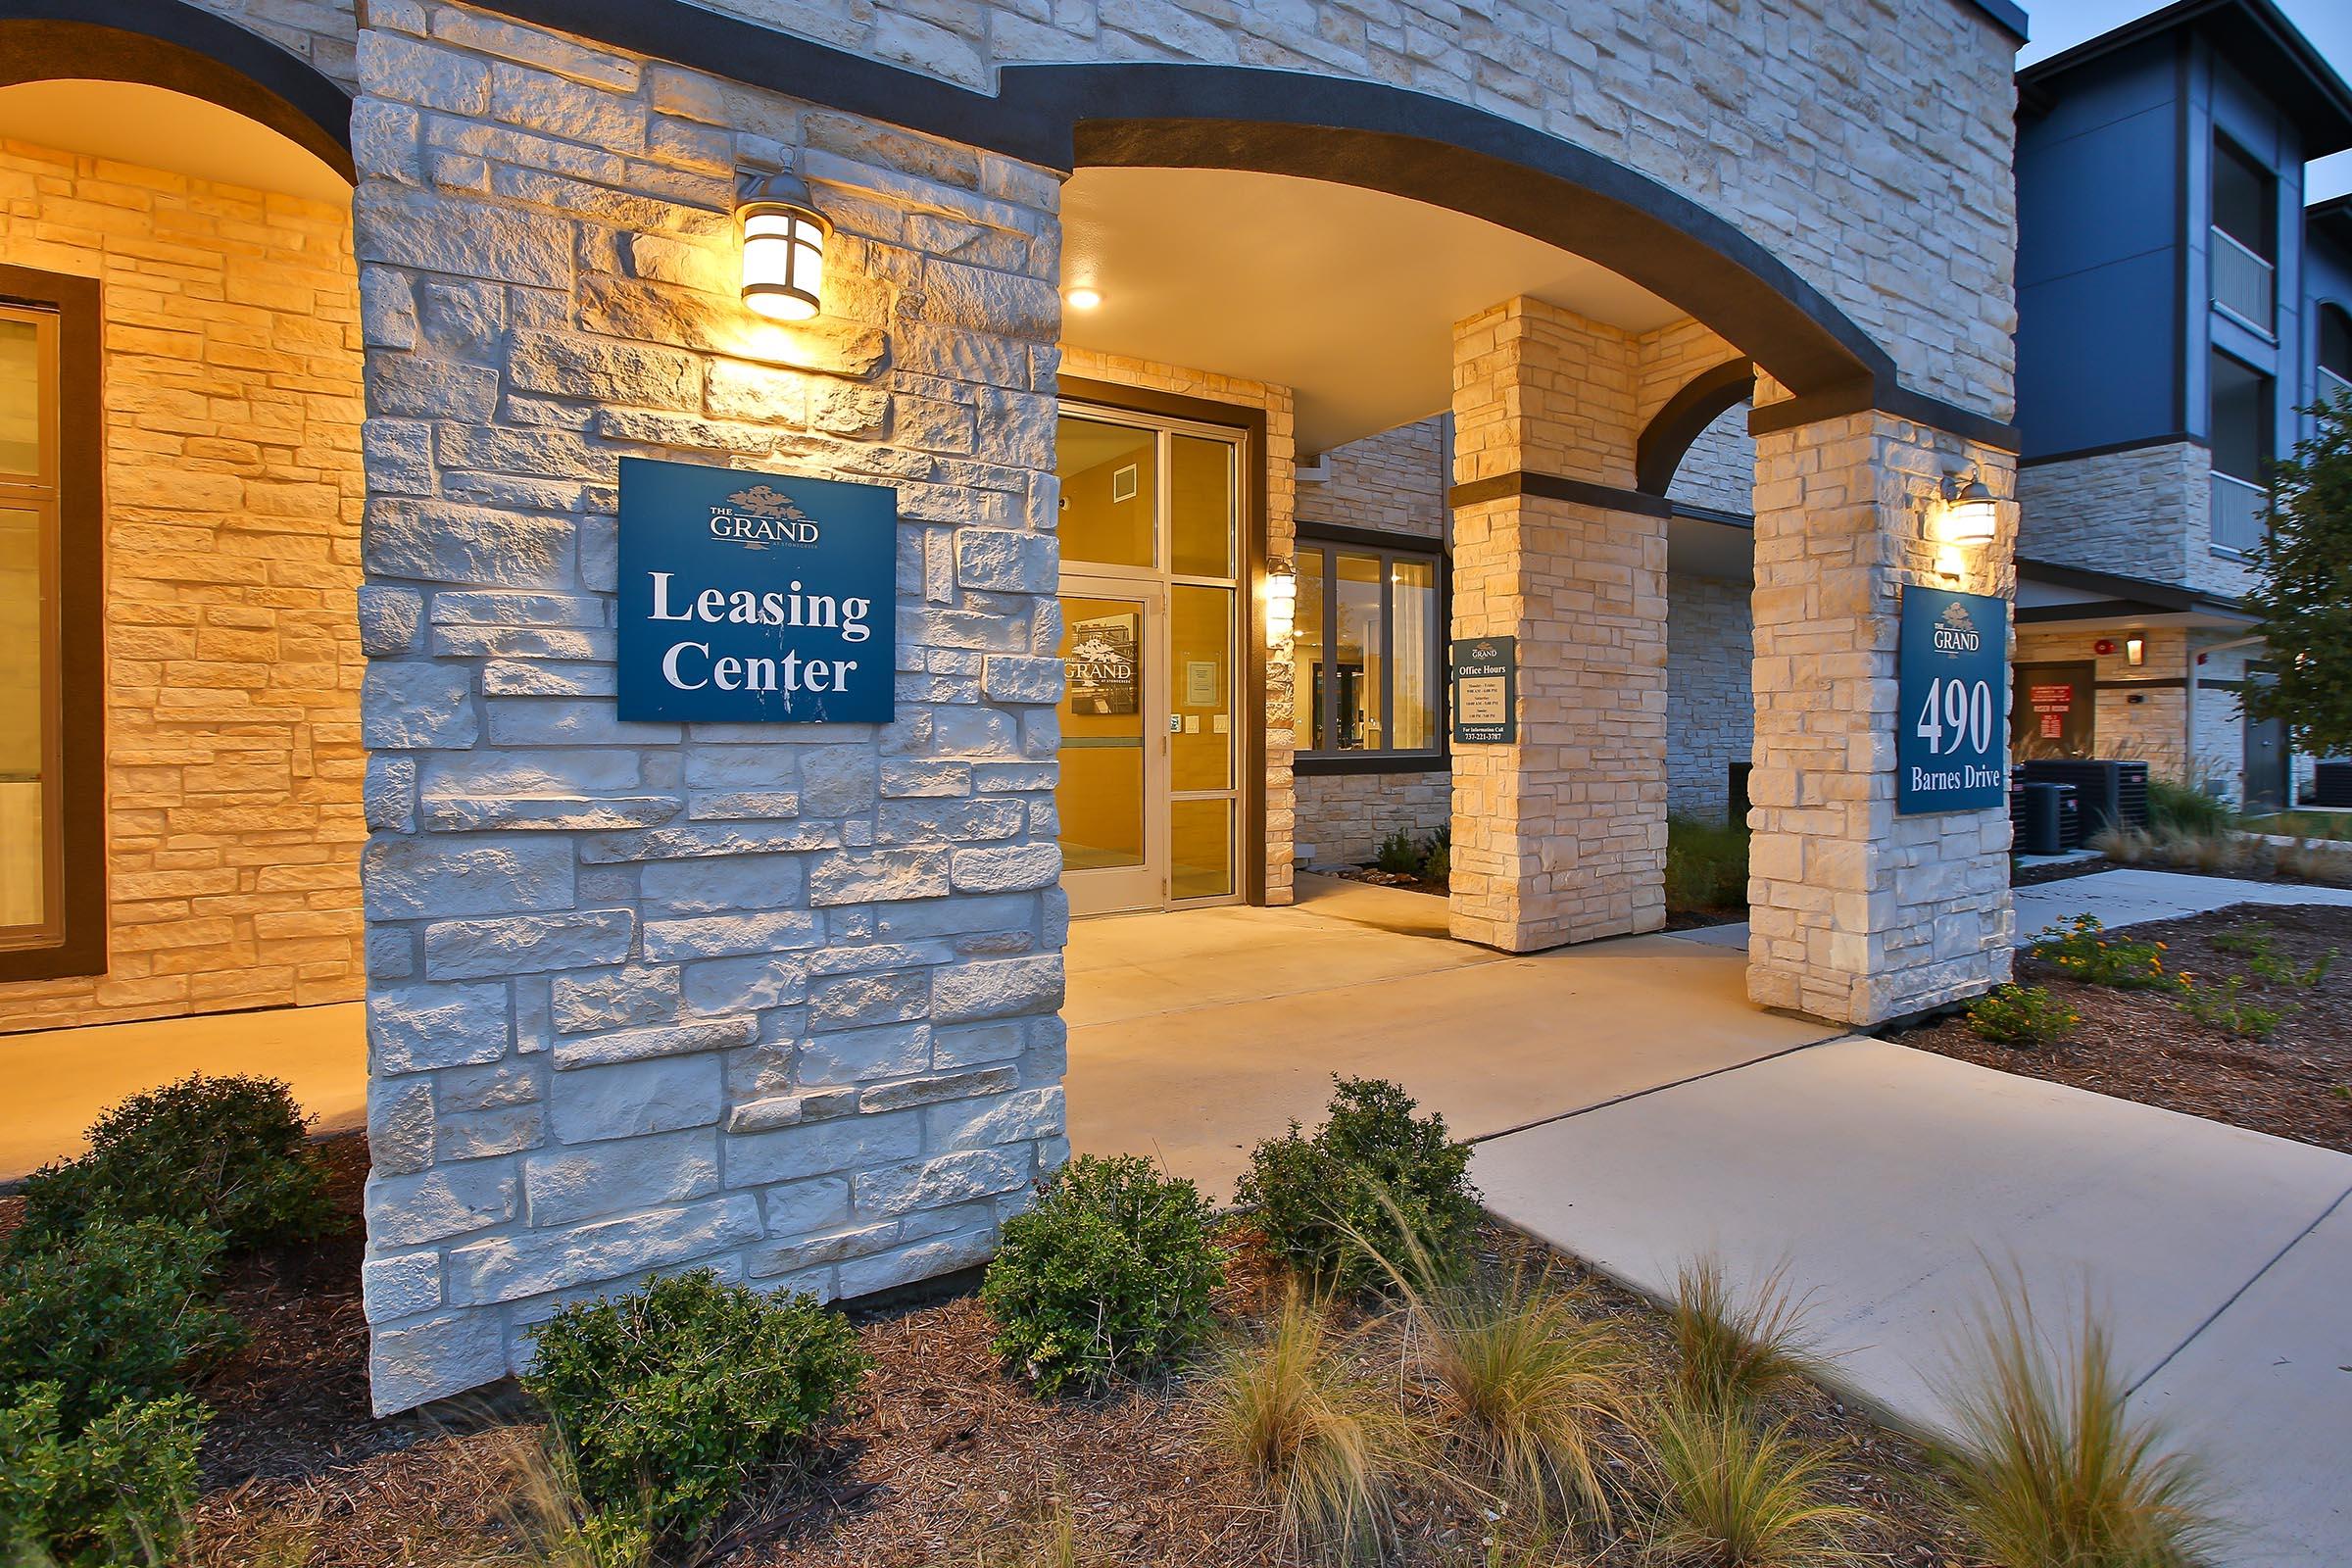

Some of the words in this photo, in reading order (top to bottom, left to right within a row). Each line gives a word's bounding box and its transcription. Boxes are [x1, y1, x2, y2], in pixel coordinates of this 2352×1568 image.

[710, 507, 733, 515] THE
[710, 515, 819, 543] GRAND
[647, 571, 871, 643] Leasing
[1934, 630, 1980, 651] GRAND
[662, 641, 858, 693] Center
[1064, 662, 1131, 679] GRAND
[1459, 665, 1482, 675] Office
[1483, 664, 1506, 674] Hours
[1917, 677, 1992, 755] 490
[1911, 766, 1961, 792] Barnes
[1964, 764, 2000, 789] Drive
